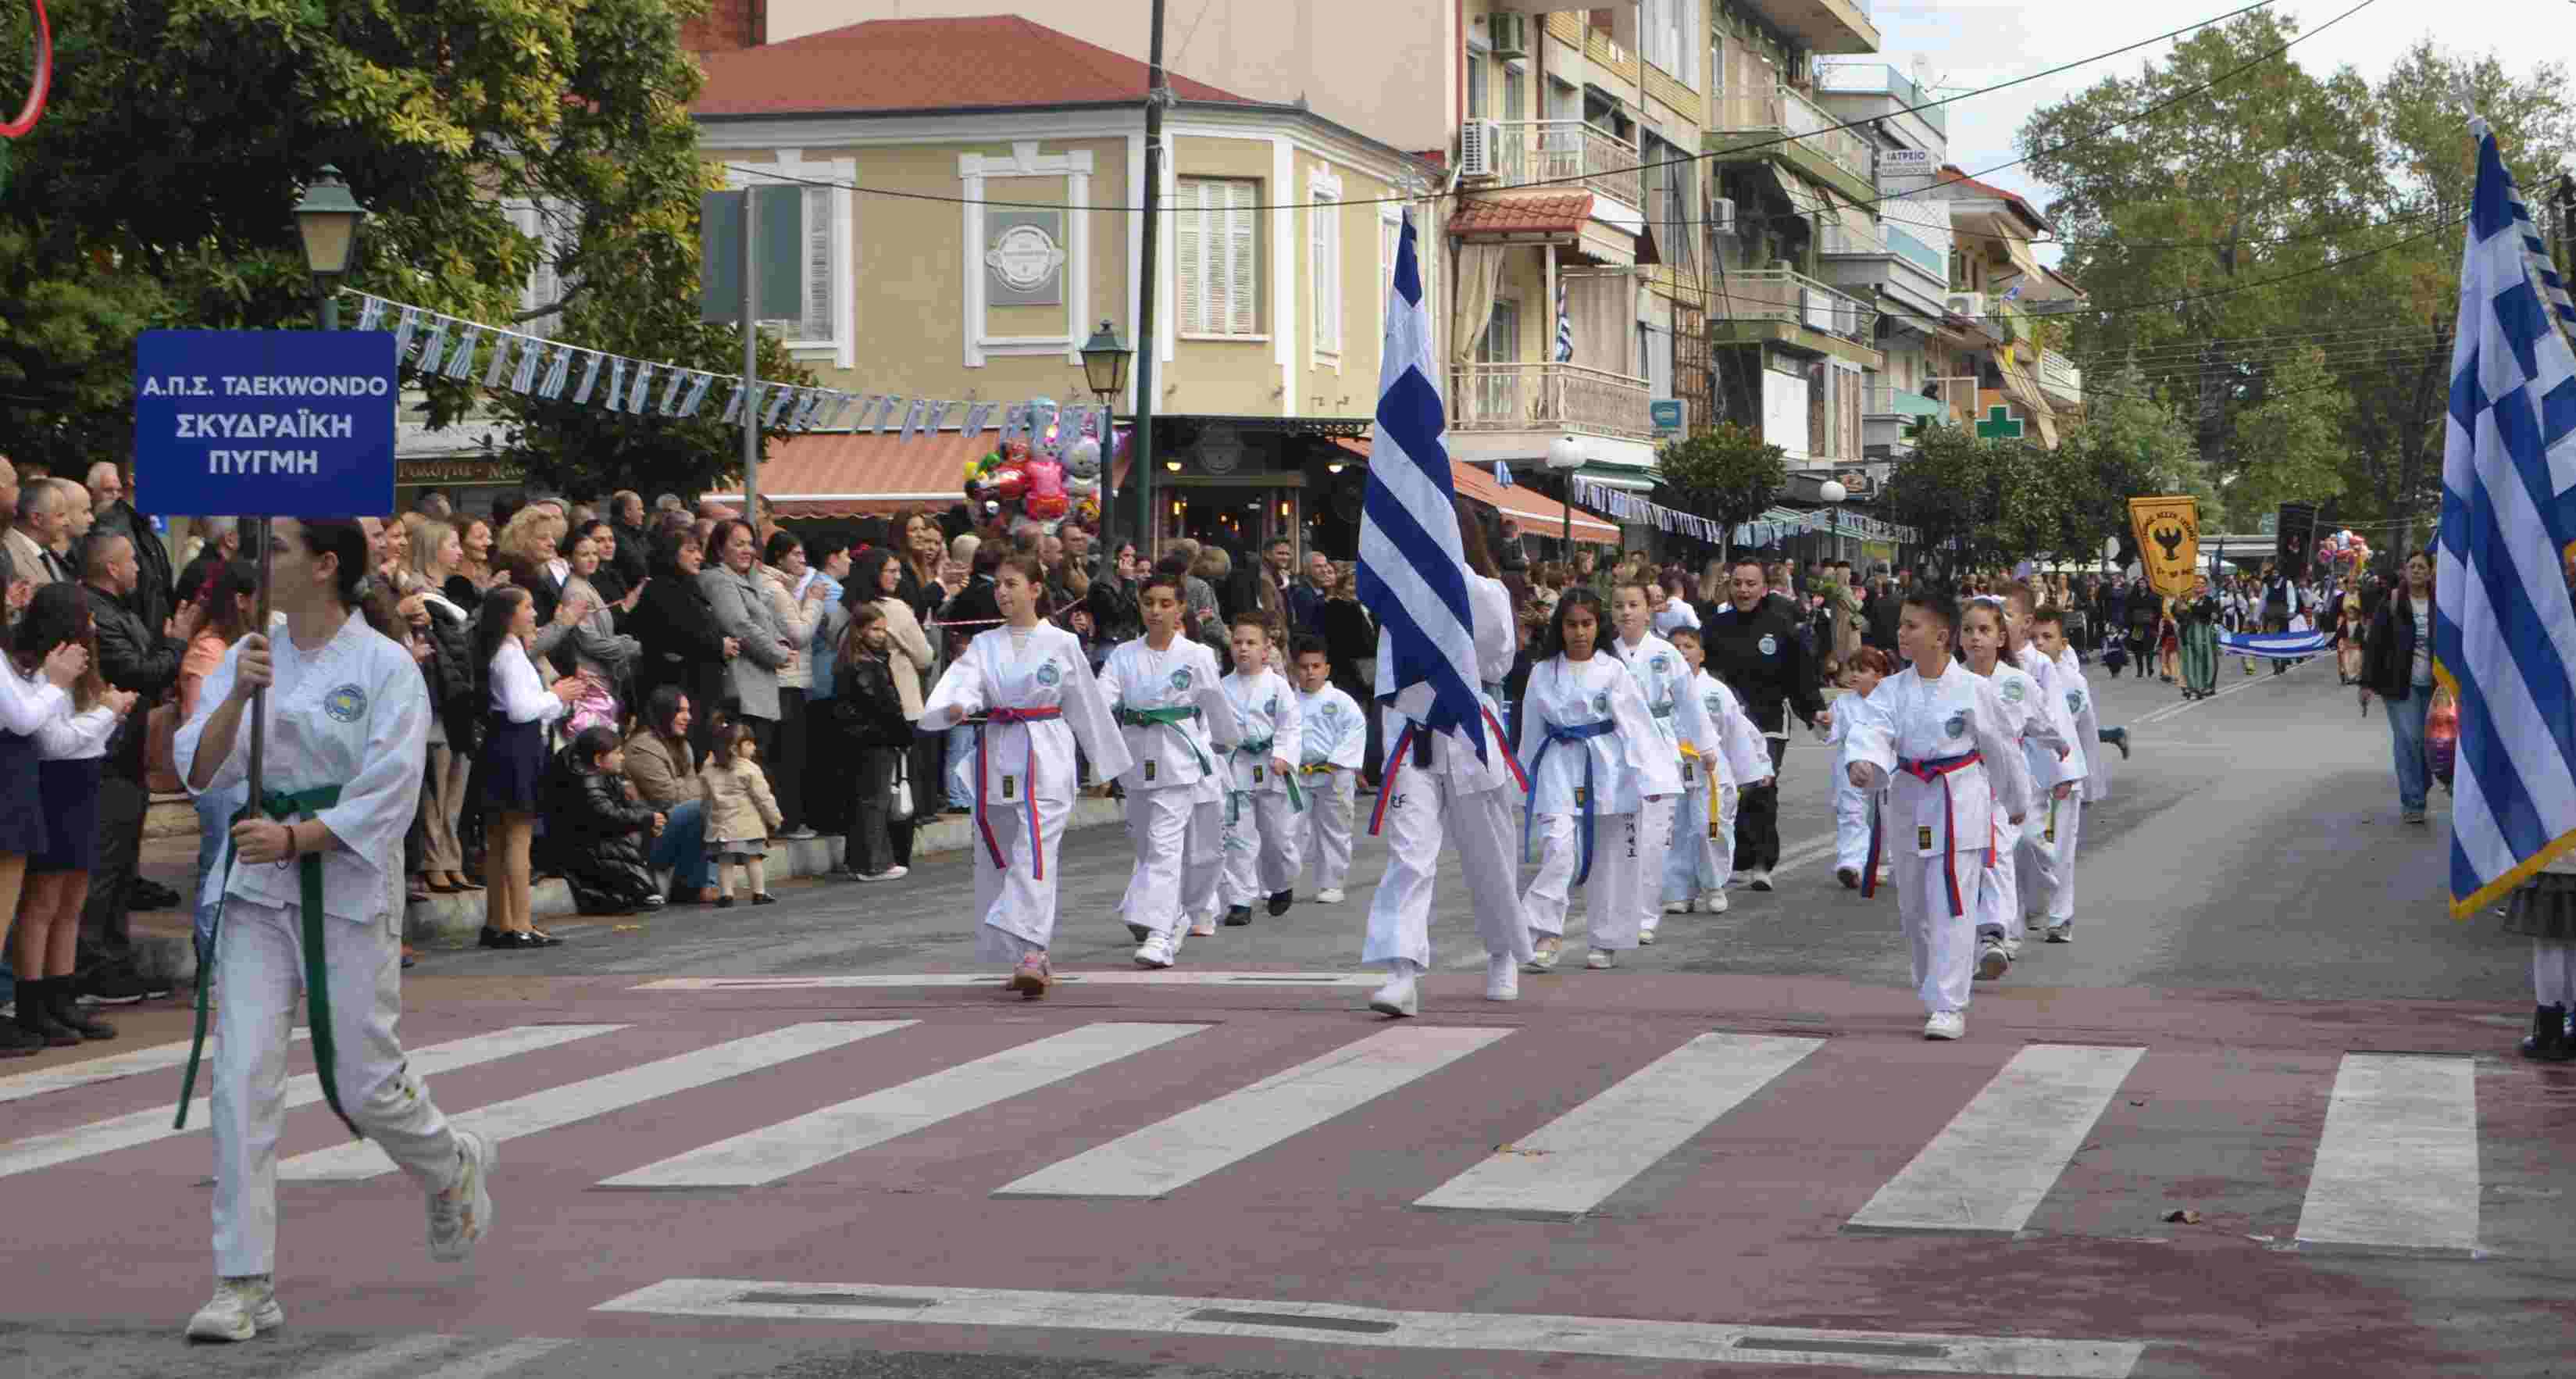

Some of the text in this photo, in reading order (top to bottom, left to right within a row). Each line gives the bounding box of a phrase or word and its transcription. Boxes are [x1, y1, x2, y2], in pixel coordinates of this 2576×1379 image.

[141, 376, 388, 396] Α.Π.Σ. TAEKWONDO
[175, 408, 352, 438] ΣΚΥΔΡΑΪΚΗ
[209, 449, 319, 474] ΠΥΓΜΗ
